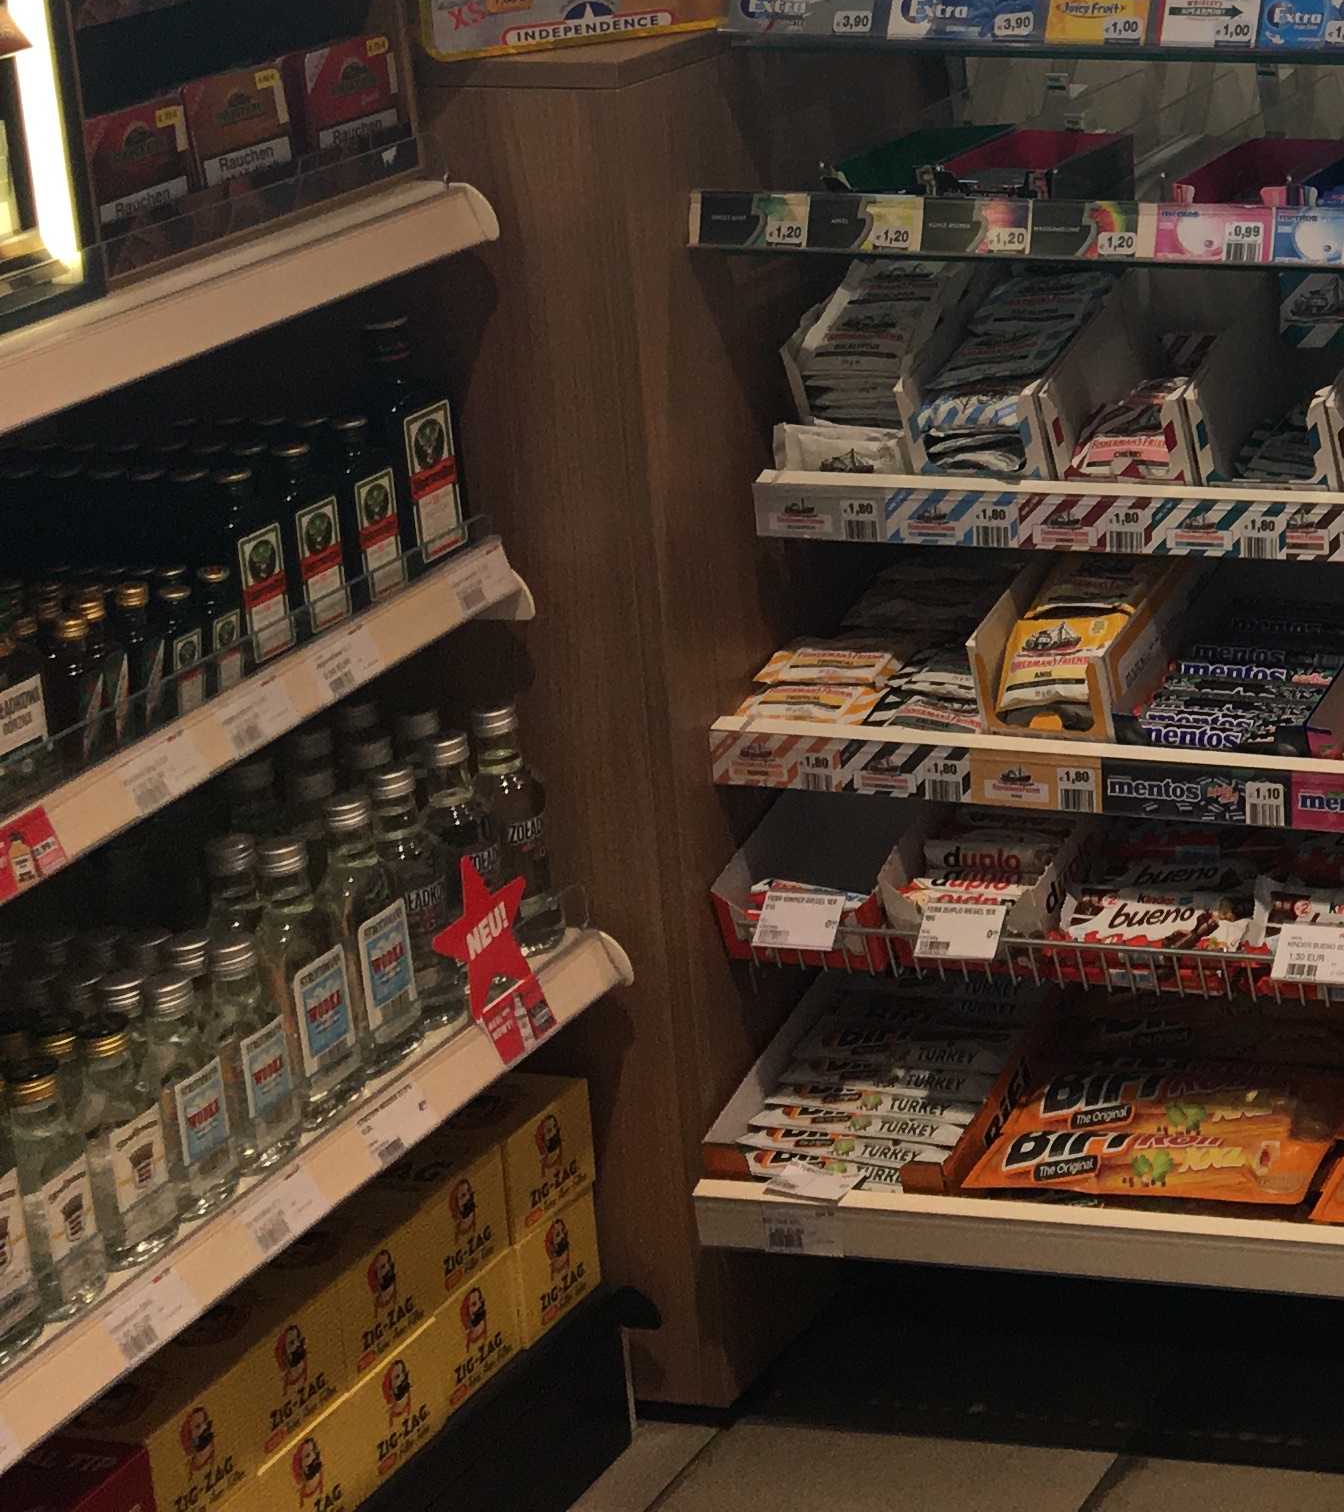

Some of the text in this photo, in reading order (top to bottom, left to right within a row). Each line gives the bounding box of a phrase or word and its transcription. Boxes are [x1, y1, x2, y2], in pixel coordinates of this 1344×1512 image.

[515, 12, 661, 43] INDEPENDENCE
[1111, 20, 1139, 35] 1,00
[219, 144, 274, 170] Rauchen
[775, 225, 801, 240] 1,20
[1106, 778, 1200, 801] mentos
[1254, 788, 1280, 801] 1,10
[943, 845, 1021, 868] duplo
[1108, 903, 1195, 928] bueno
[466, 902, 508, 962] NEU!
[890, 1098, 950, 1116] TURKEY
[1040, 1158, 1095, 1175] The Original
[530, 1160, 579, 1208] ZIG-ZAG
[443, 1227, 493, 1275] ZIG-ZAG
